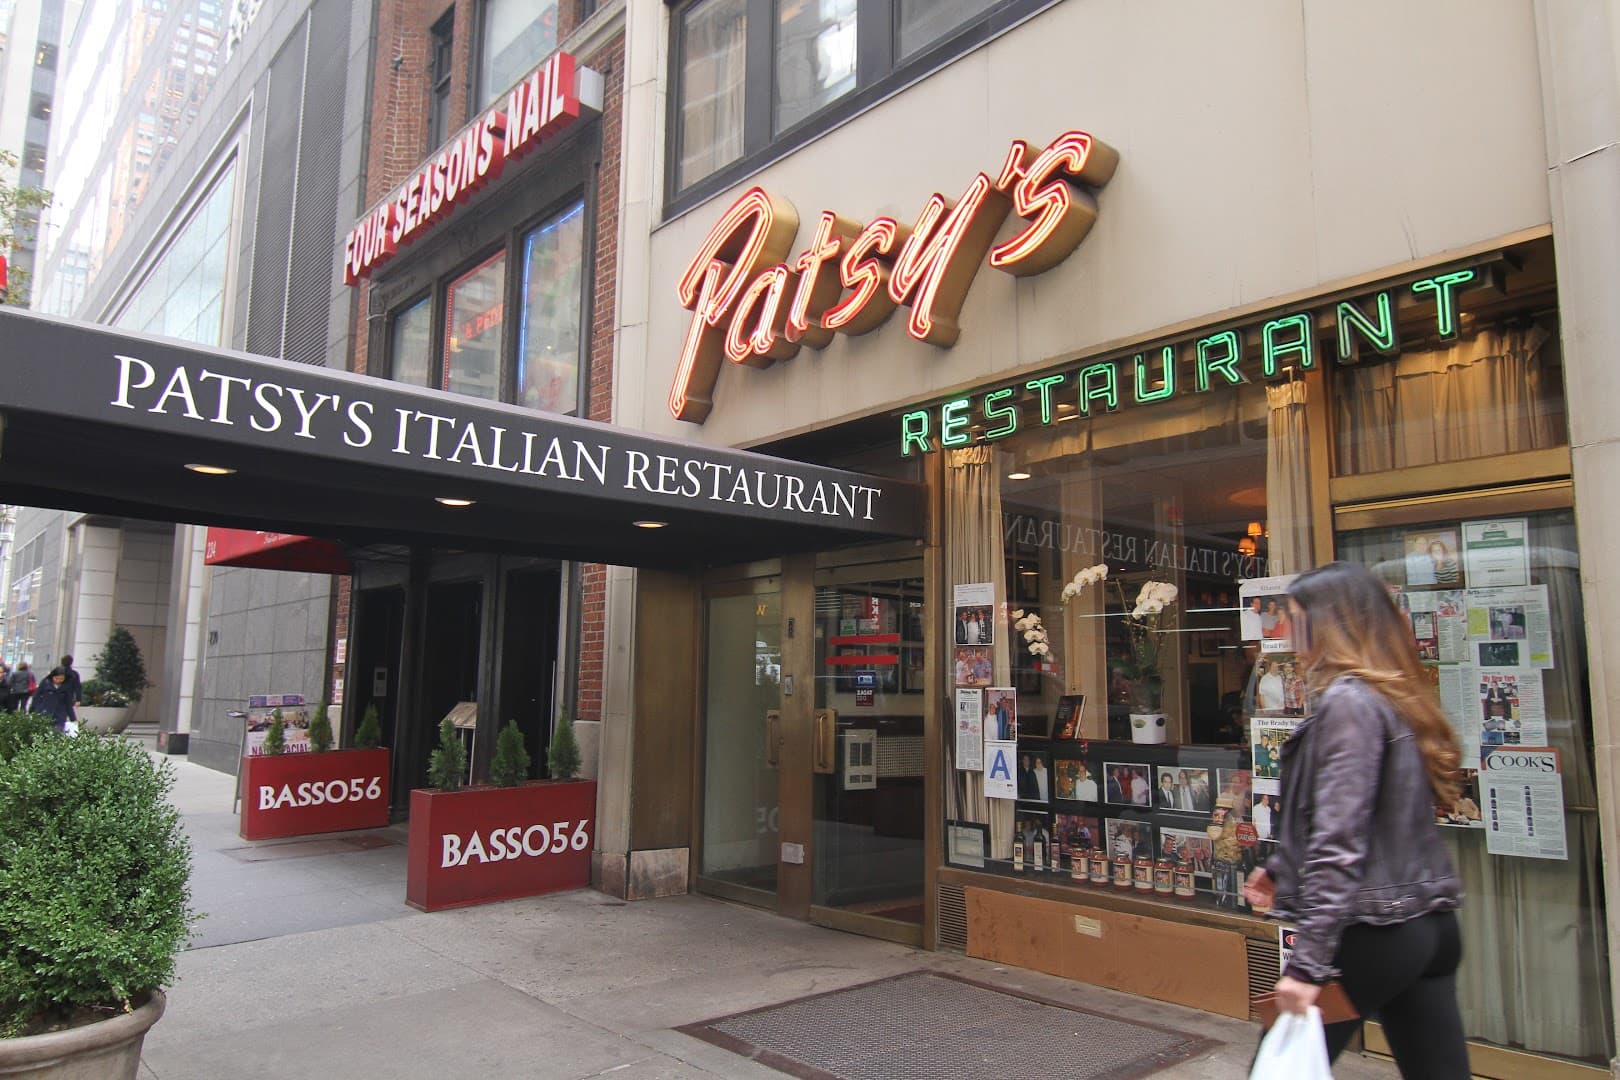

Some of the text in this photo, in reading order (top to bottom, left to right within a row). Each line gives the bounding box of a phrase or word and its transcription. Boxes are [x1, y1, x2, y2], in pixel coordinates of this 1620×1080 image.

[344, 52, 566, 283] FOUR SEASONS NAIL
[669, 130, 1095, 420] Patsy's
[902, 270, 1475, 456] RESTAURANT
[110, 355, 882, 520] PATSY'S ITALIAN RESTAURANT
[259, 777, 382, 810] BASSO56
[989, 749, 1011, 780] A
[1487, 754, 1555, 773] COOK'S
[441, 819, 590, 868] BASSO56
